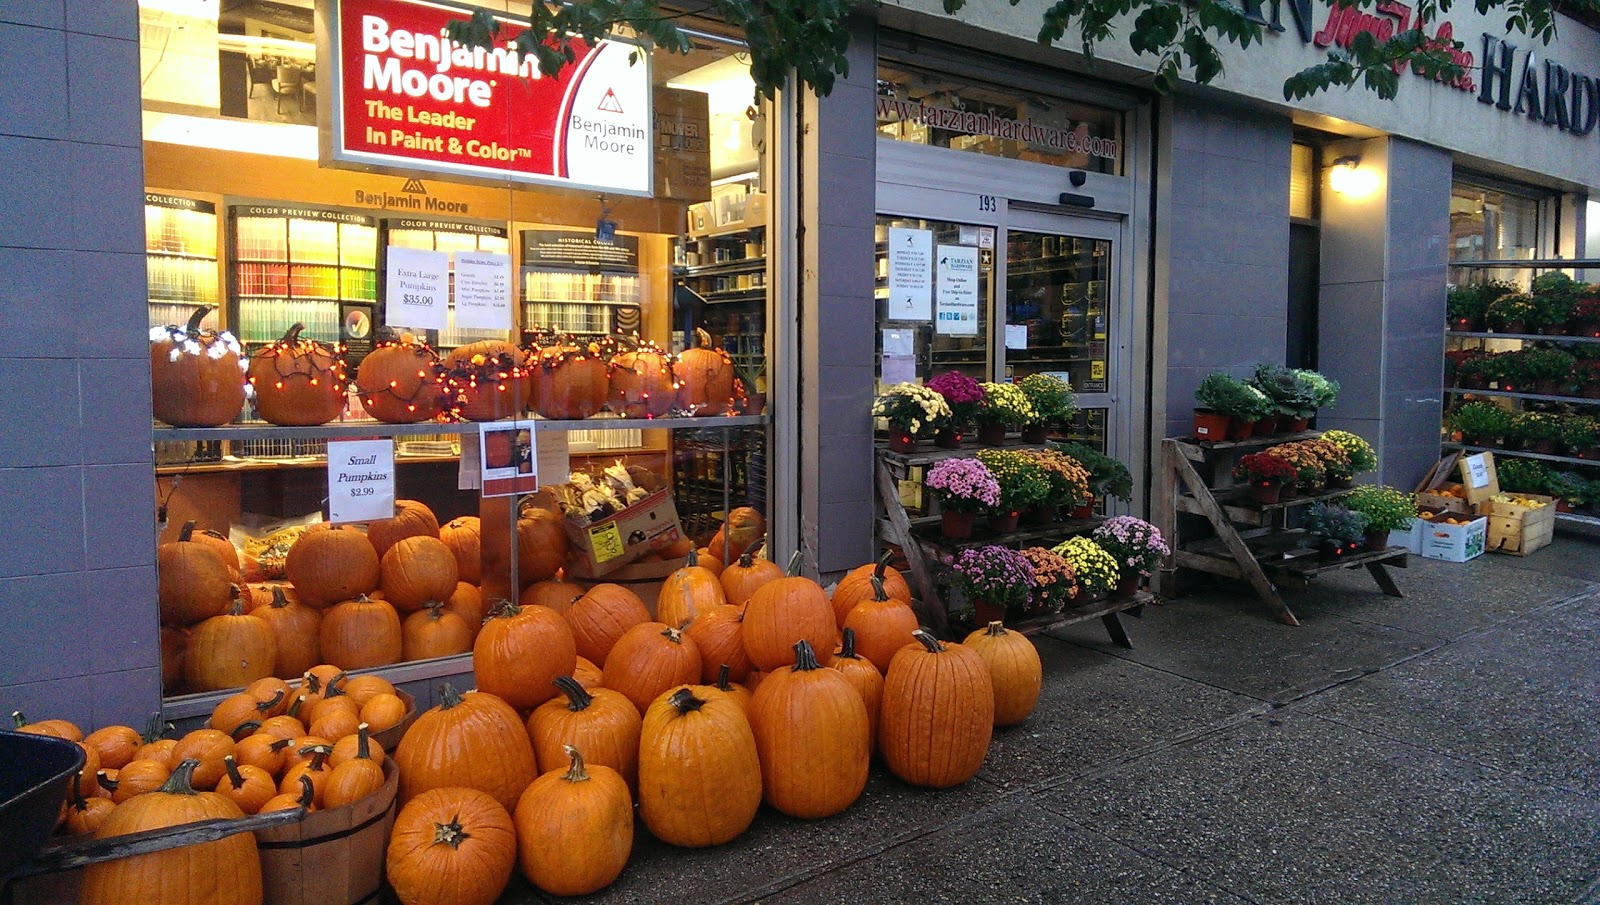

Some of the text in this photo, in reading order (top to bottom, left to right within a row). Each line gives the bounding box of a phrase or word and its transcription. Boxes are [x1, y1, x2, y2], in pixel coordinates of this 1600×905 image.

[362, 14, 542, 80] Benjamin
[363, 53, 492, 107] Moore
[1477, 32, 1600, 136] HARD
[364, 99, 476, 131] The Leader
[572, 115, 645, 140] Benjamin
[366, 126, 387, 146] In
[391, 129, 444, 153] Paint
[448, 137, 463, 155] &
[584, 134, 635, 155] Moore
[146, 194, 196, 208] COLLECTION
[355, 189, 469, 213] Benjamin Moore
[979, 194, 996, 212] 193
[250, 207, 366, 223] COLOR PREVIEW COLLECTION
[400, 219, 501, 235] COLOR PREVIEW COLLECTION
[397, 268, 440, 281] Extra Large
[400, 280, 437, 292] Pumpkins
[402, 293, 434, 306] $35.00
[347, 454, 377, 466] Small
[336, 470, 388, 484] Pumpkins
[350, 486, 375, 498] $2.99
